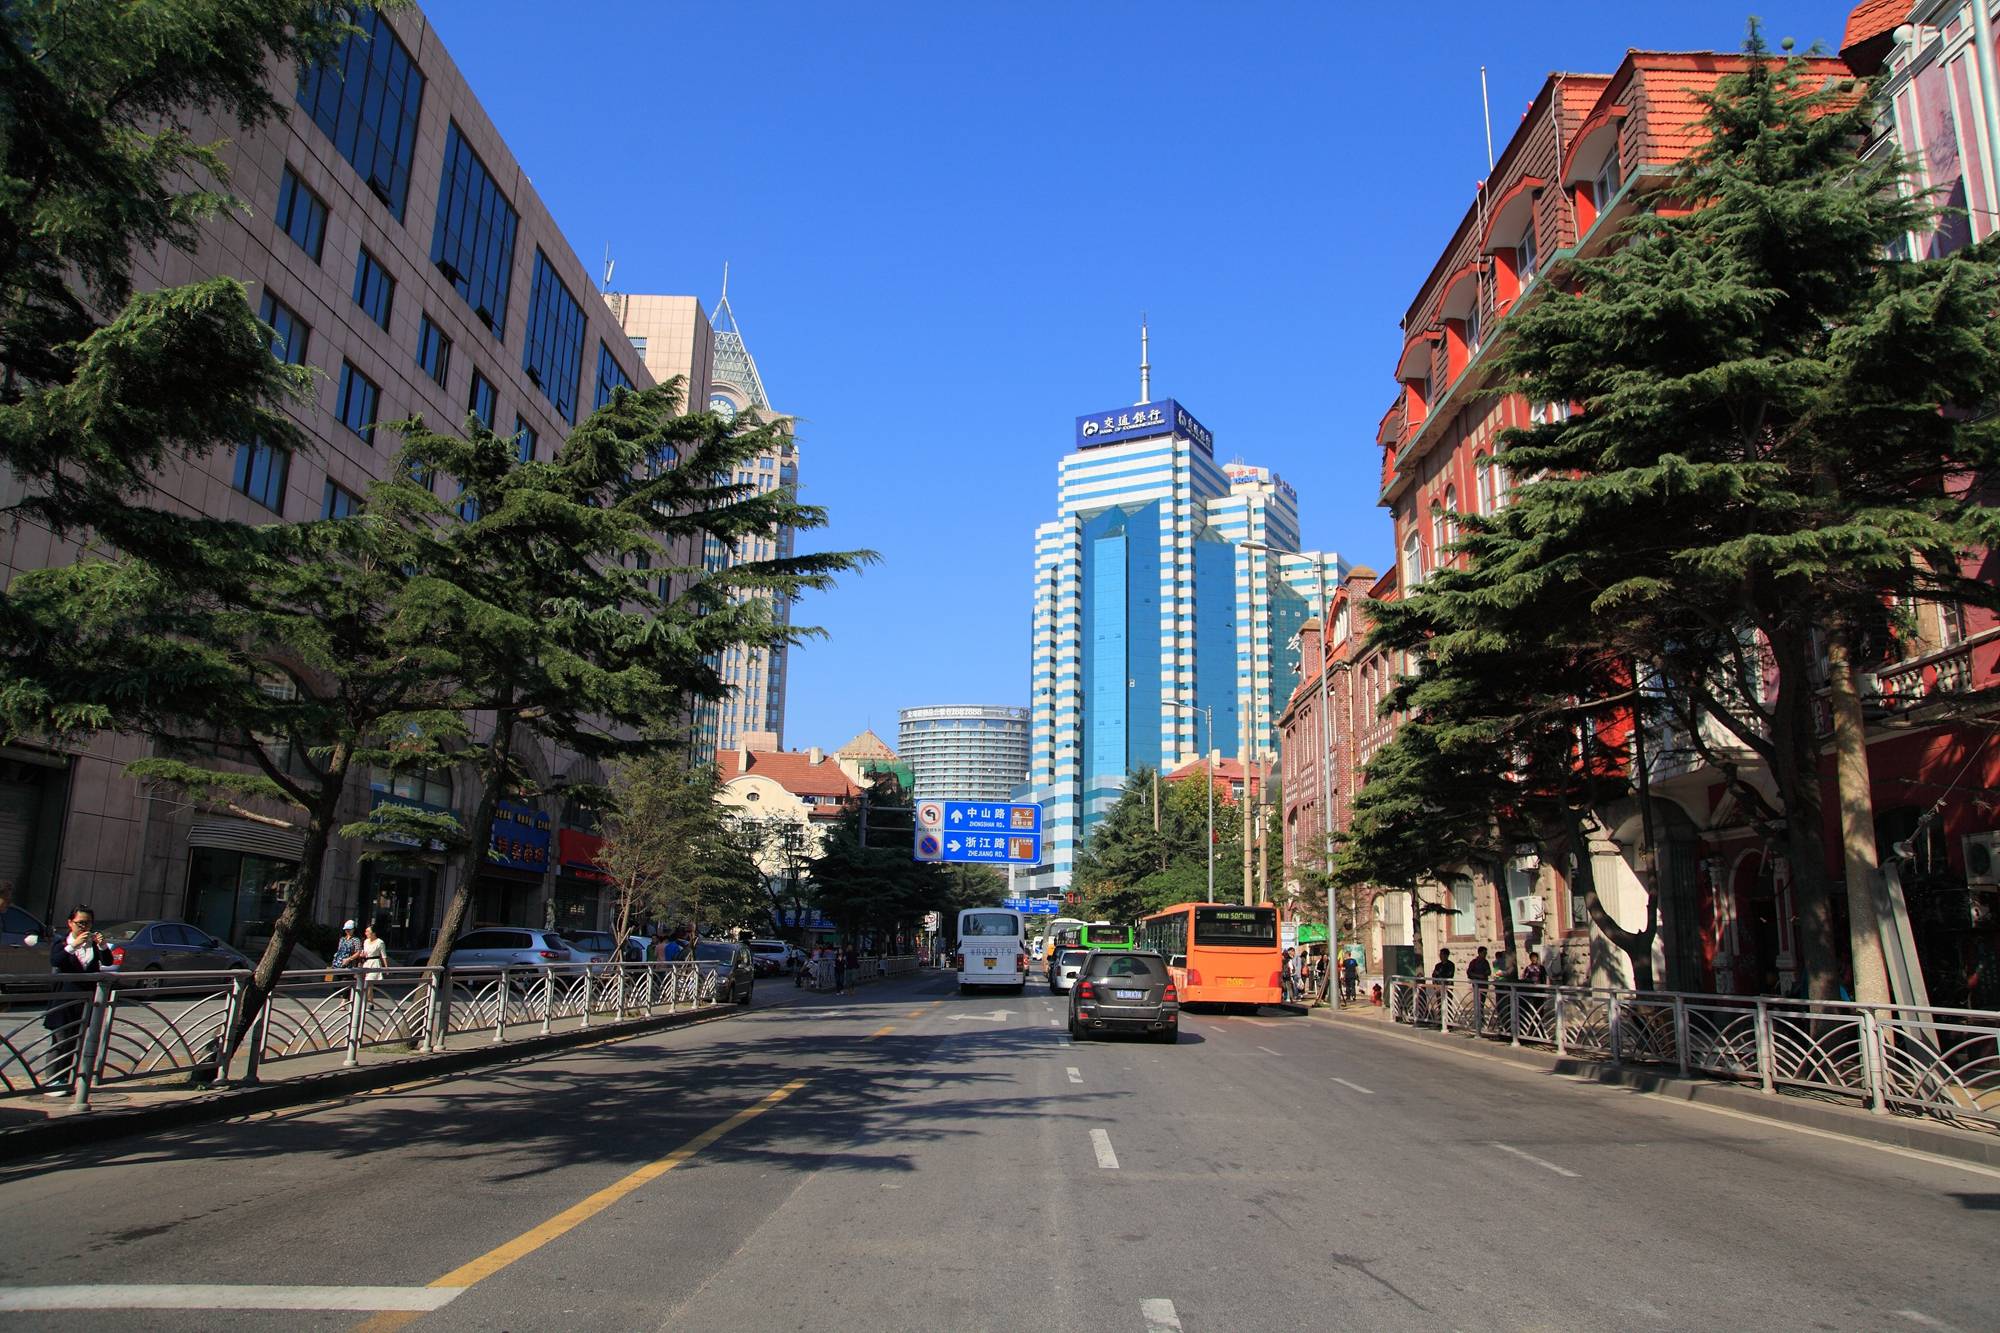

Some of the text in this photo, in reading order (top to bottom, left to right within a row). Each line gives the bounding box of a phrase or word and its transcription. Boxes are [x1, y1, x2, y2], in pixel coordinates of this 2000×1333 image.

[967, 807, 1005, 819] 中山路
[965, 836, 1006, 849] 浙江路
[994, 850, 1005, 858] RD.
